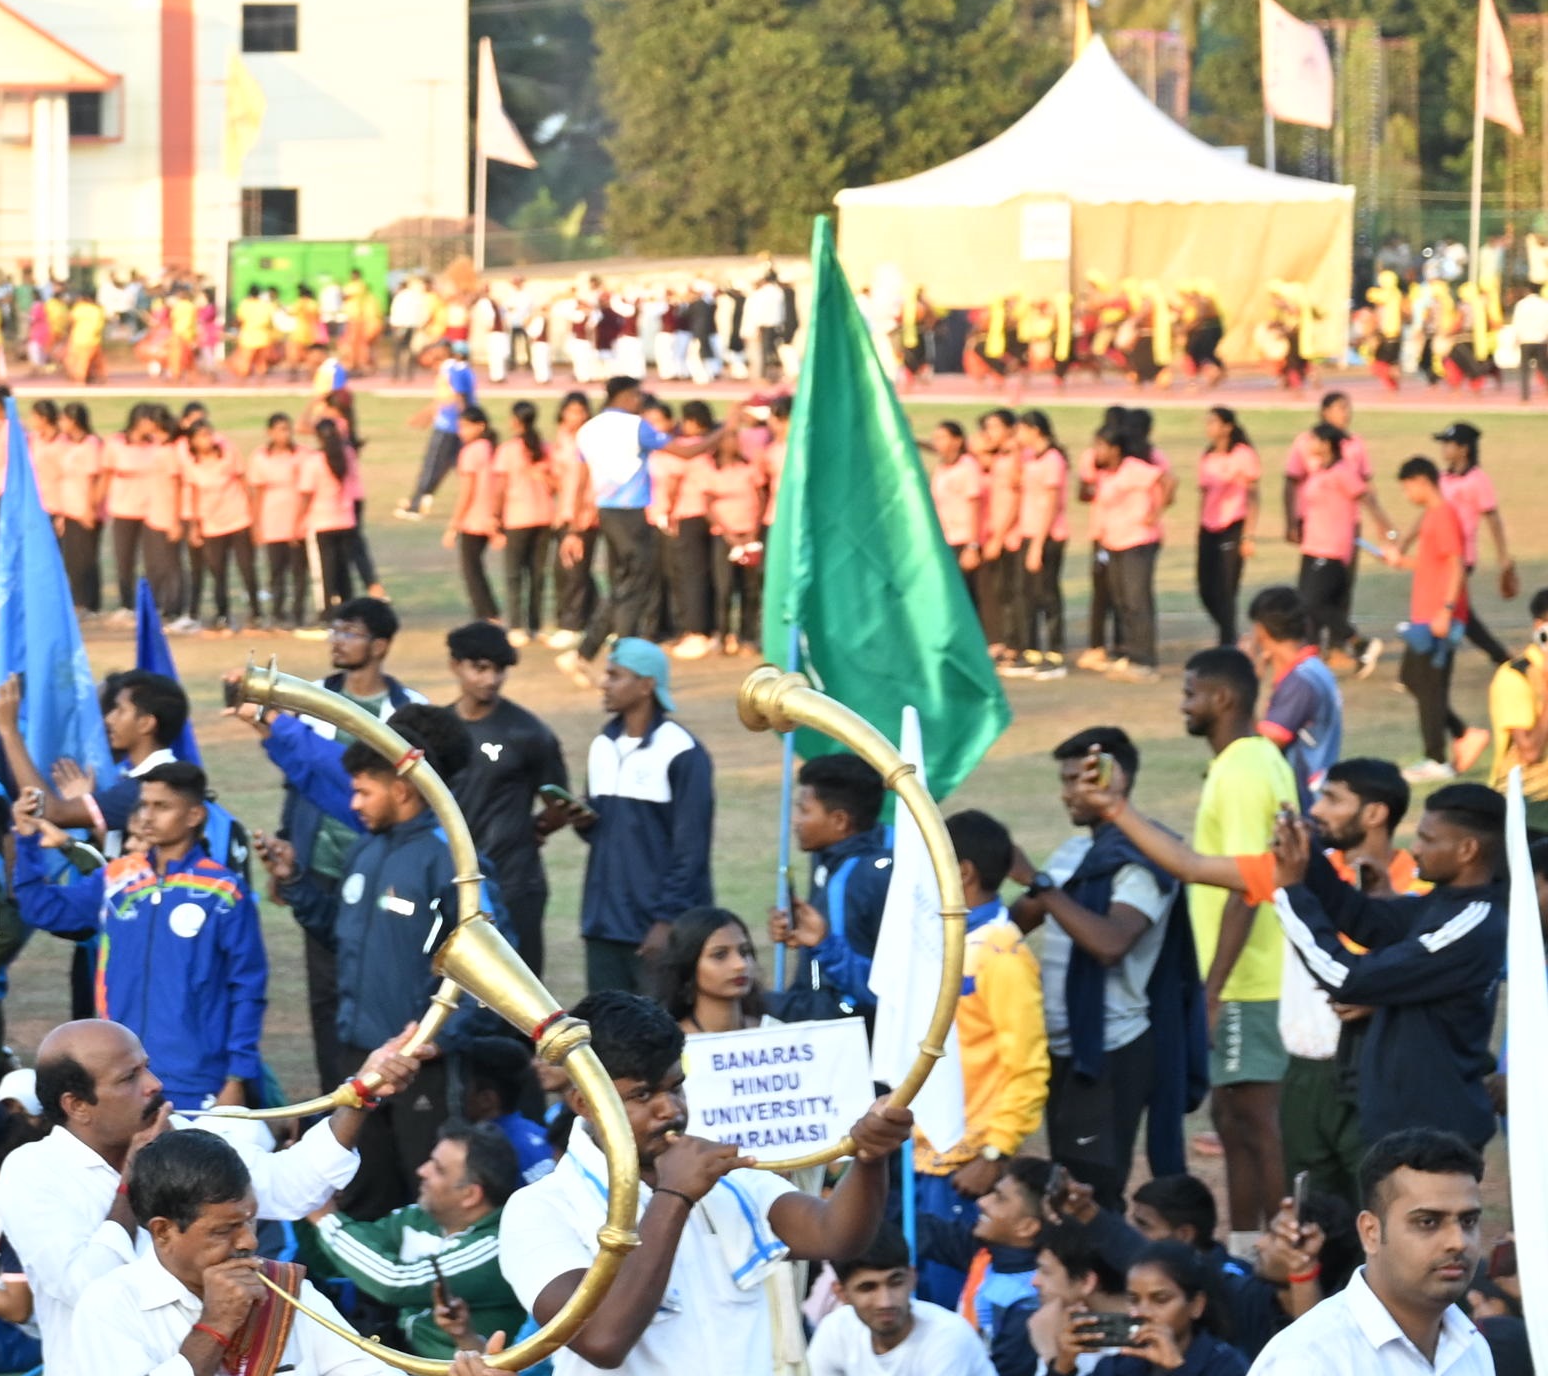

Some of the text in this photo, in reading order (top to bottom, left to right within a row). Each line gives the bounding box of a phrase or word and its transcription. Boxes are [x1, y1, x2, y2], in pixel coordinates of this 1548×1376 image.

[711, 1043, 815, 1071] BANARAS
[731, 1072, 800, 1096] HINDU
[701, 1095, 839, 1127] UNIVERSITY,
